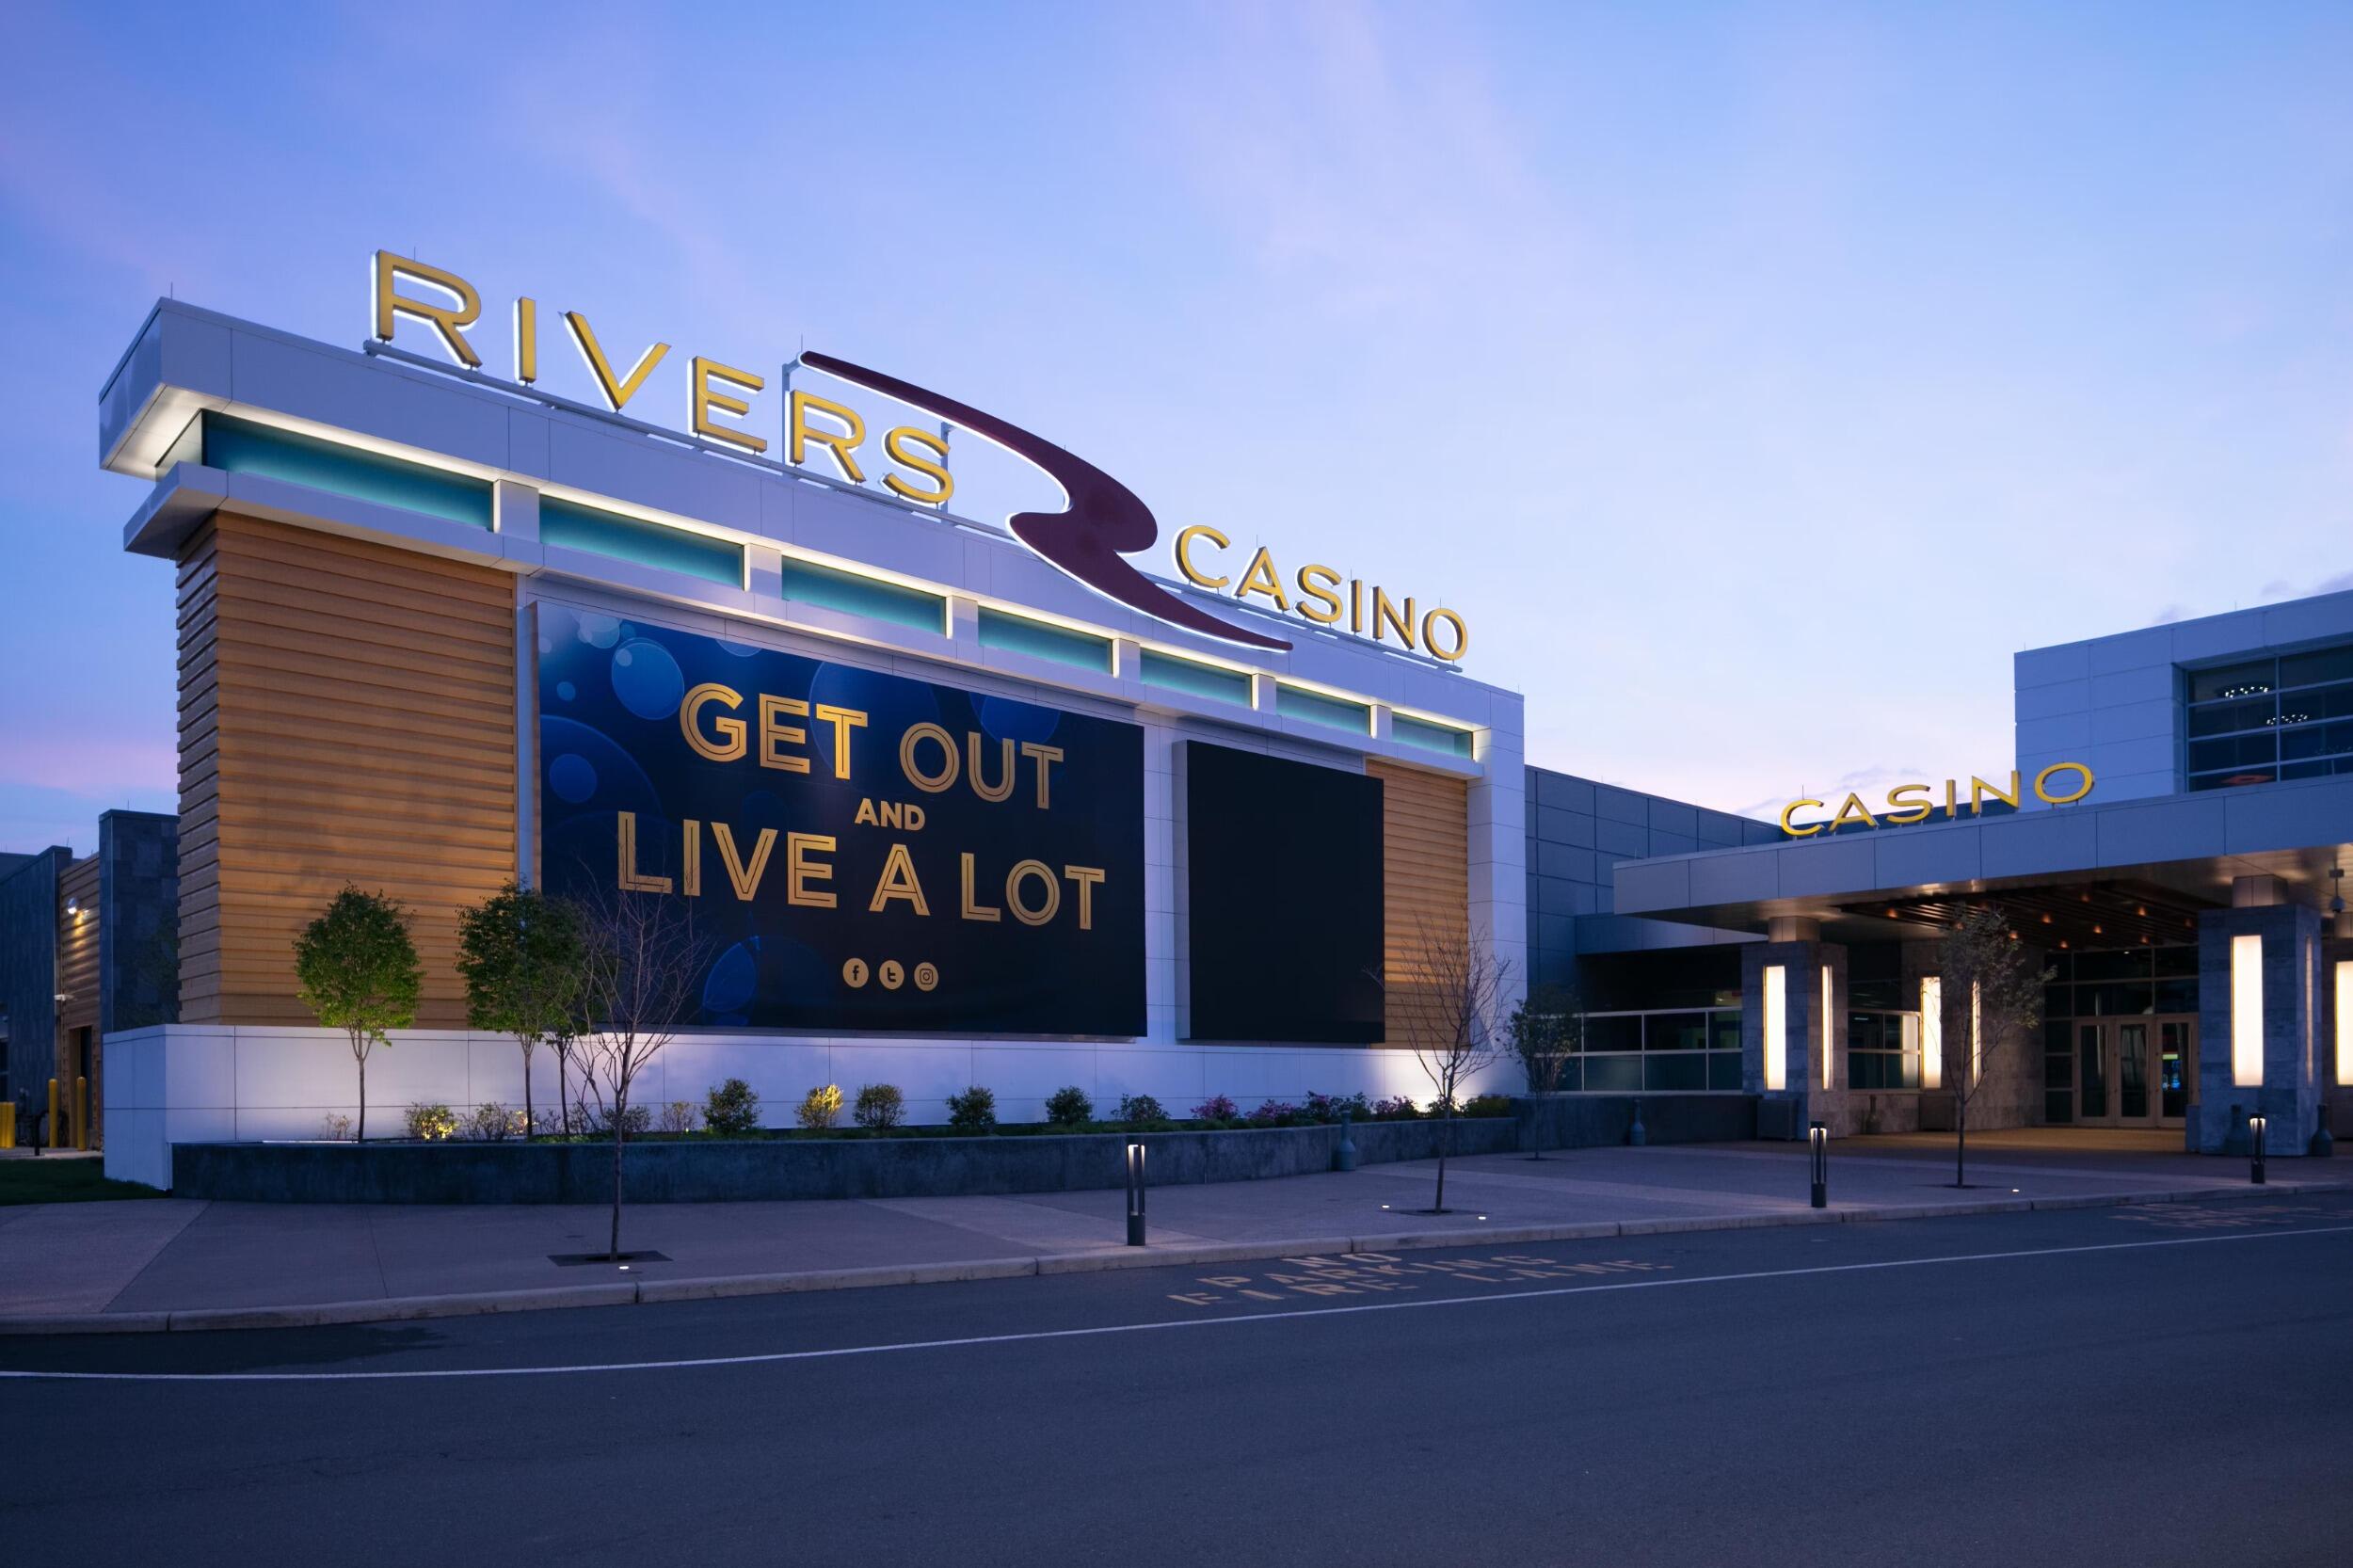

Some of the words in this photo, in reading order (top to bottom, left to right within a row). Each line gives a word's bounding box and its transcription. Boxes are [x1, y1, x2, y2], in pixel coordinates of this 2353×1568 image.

[372, 249, 954, 504] RIVERS
[1173, 525, 1468, 661] CASINO
[680, 683, 868, 779] GET
[900, 722, 1064, 809] OUT
[855, 798, 925, 831] AND
[1780, 761, 2094, 837] CASINO
[617, 811, 838, 908] LIVE
[869, 844, 931, 916] A
[961, 852, 1105, 930] LOT
[1166, 1279, 1419, 1305] FIRE
[1450, 1260, 1674, 1282] LANE
[1195, 1256, 1557, 1288] PARKING
[1281, 1253, 1402, 1267] NO
